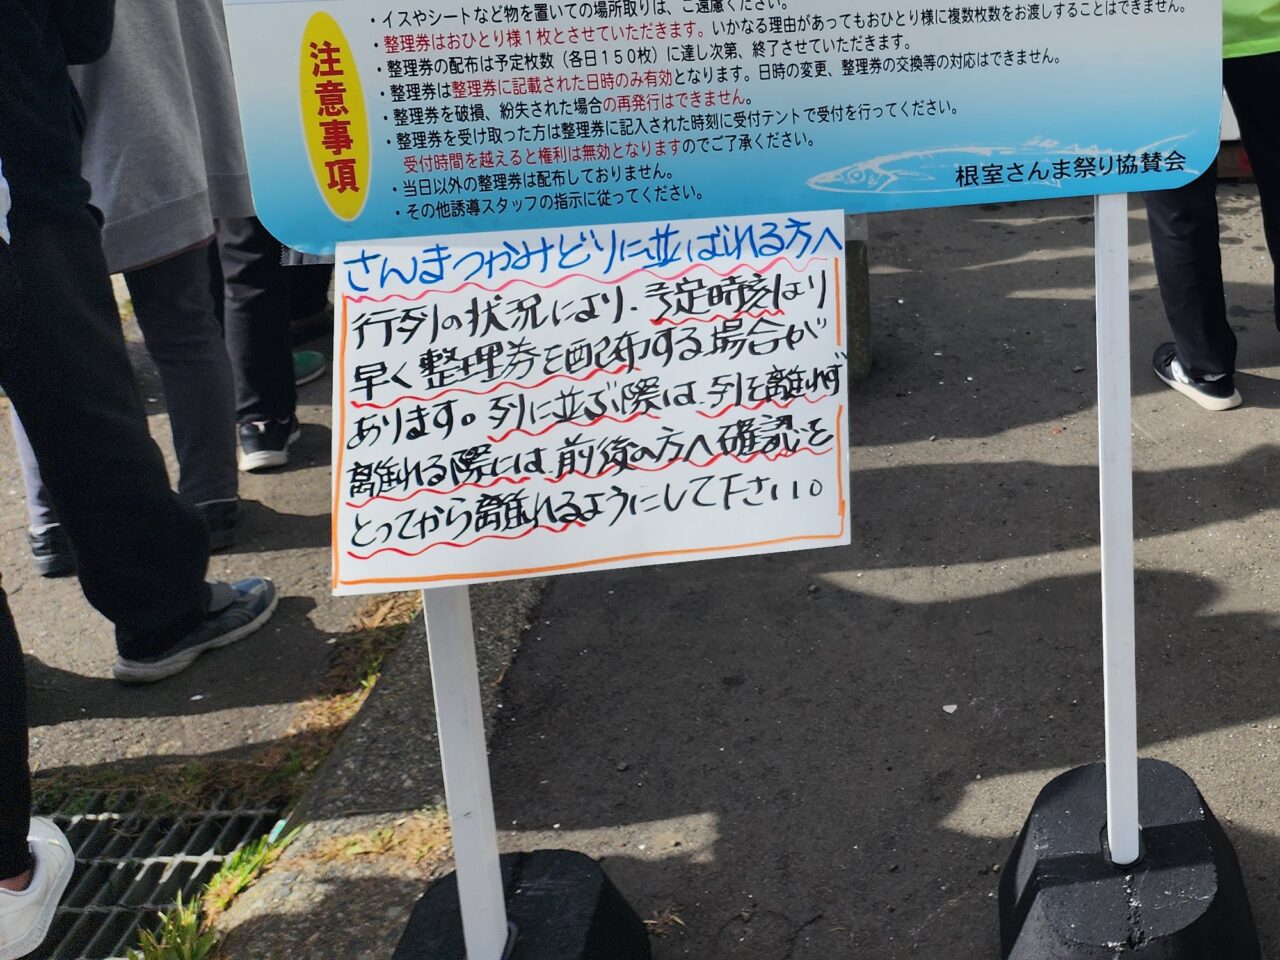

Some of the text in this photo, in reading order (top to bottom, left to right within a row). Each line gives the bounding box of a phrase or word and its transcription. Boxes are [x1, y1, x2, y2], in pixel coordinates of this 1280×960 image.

[309, 40, 360, 194] 注意事項
[955, 150, 1187, 188] 根室さんま祭り協賛会
